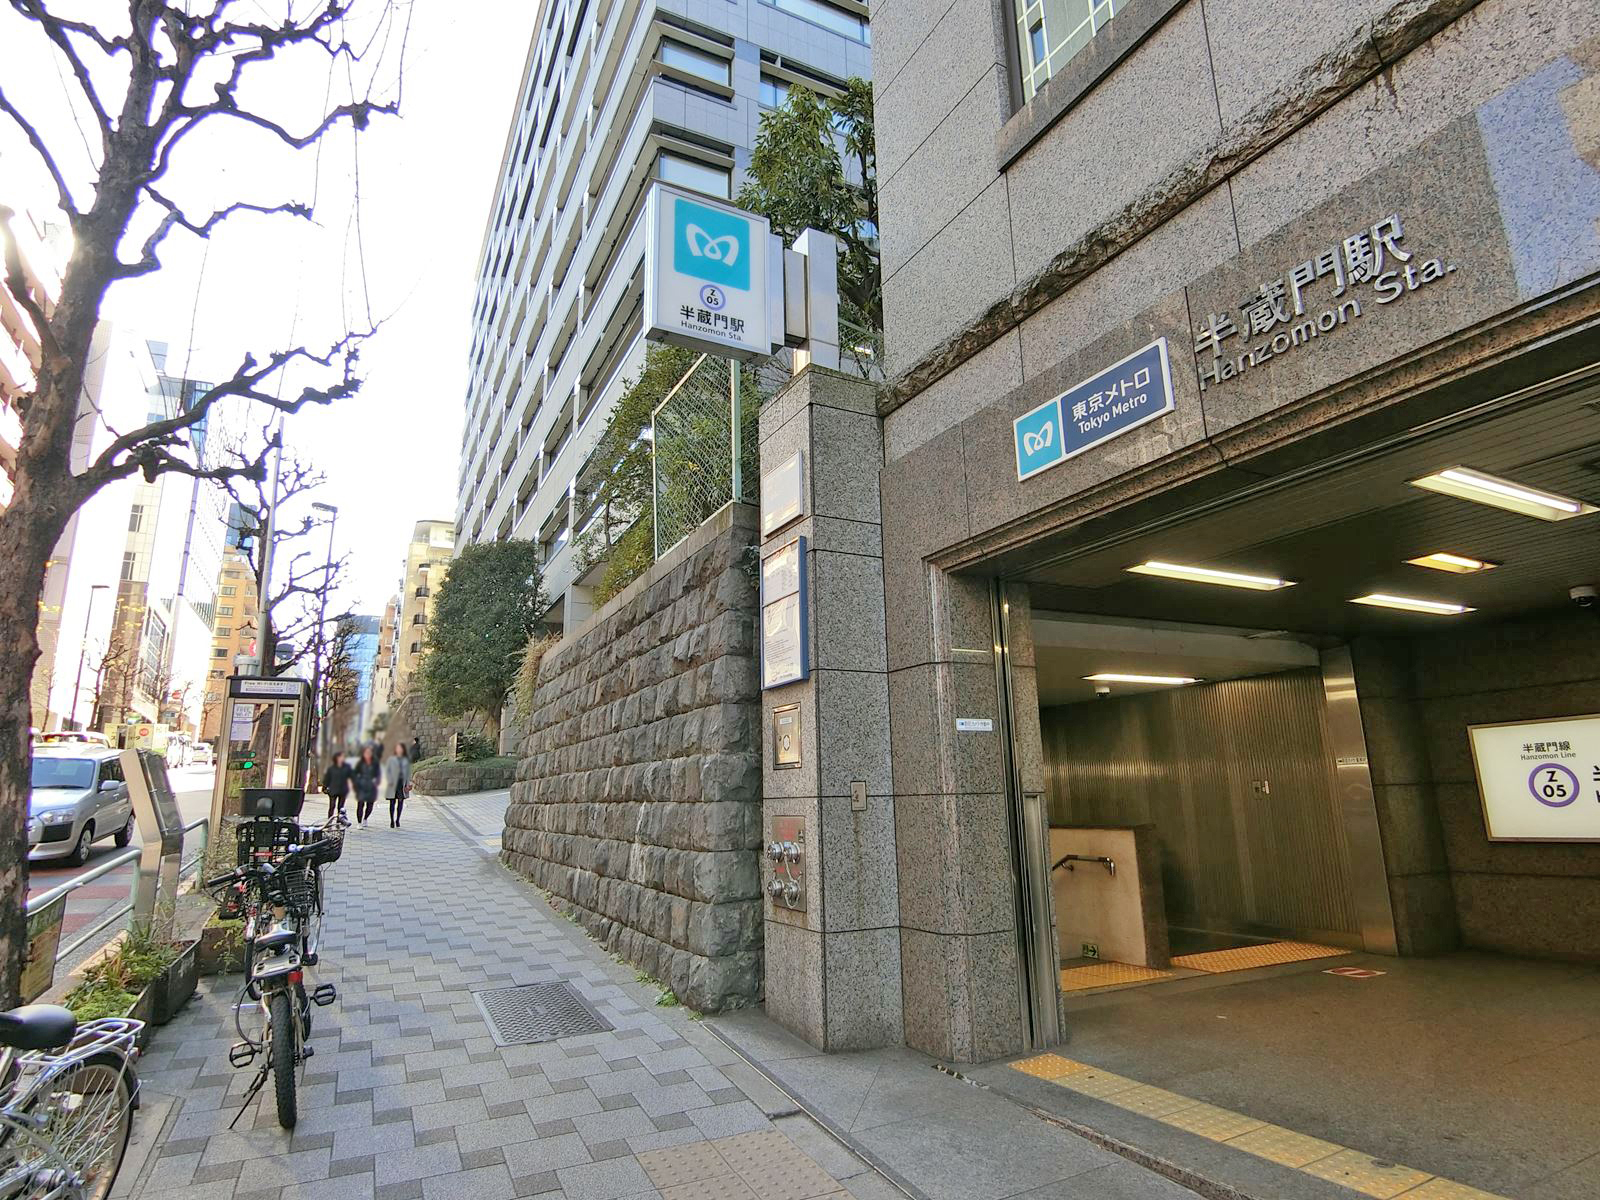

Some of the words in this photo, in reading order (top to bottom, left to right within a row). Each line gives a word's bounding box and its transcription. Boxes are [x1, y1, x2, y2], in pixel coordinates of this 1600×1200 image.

[1195, 214, 1412, 357] 半蔵門駅
[706, 296, 719, 306] 05
[680, 305, 744, 333] 半蔵門駅
[681, 320, 726, 337] Hanzomon
[729, 332, 744, 342] Sta.
[1200, 299, 1361, 391] Hanzomon
[1375, 256, 1456, 303] Sta.
[1072, 367, 1150, 422] 東京メトロ
[1078, 412, 1110, 434] Tokyo
[1112, 393, 1147, 418] Metro
[1523, 741, 1571, 753] 半蔵門線
[1546, 771, 1558, 782] Z
[1543, 785, 1567, 797] 05
